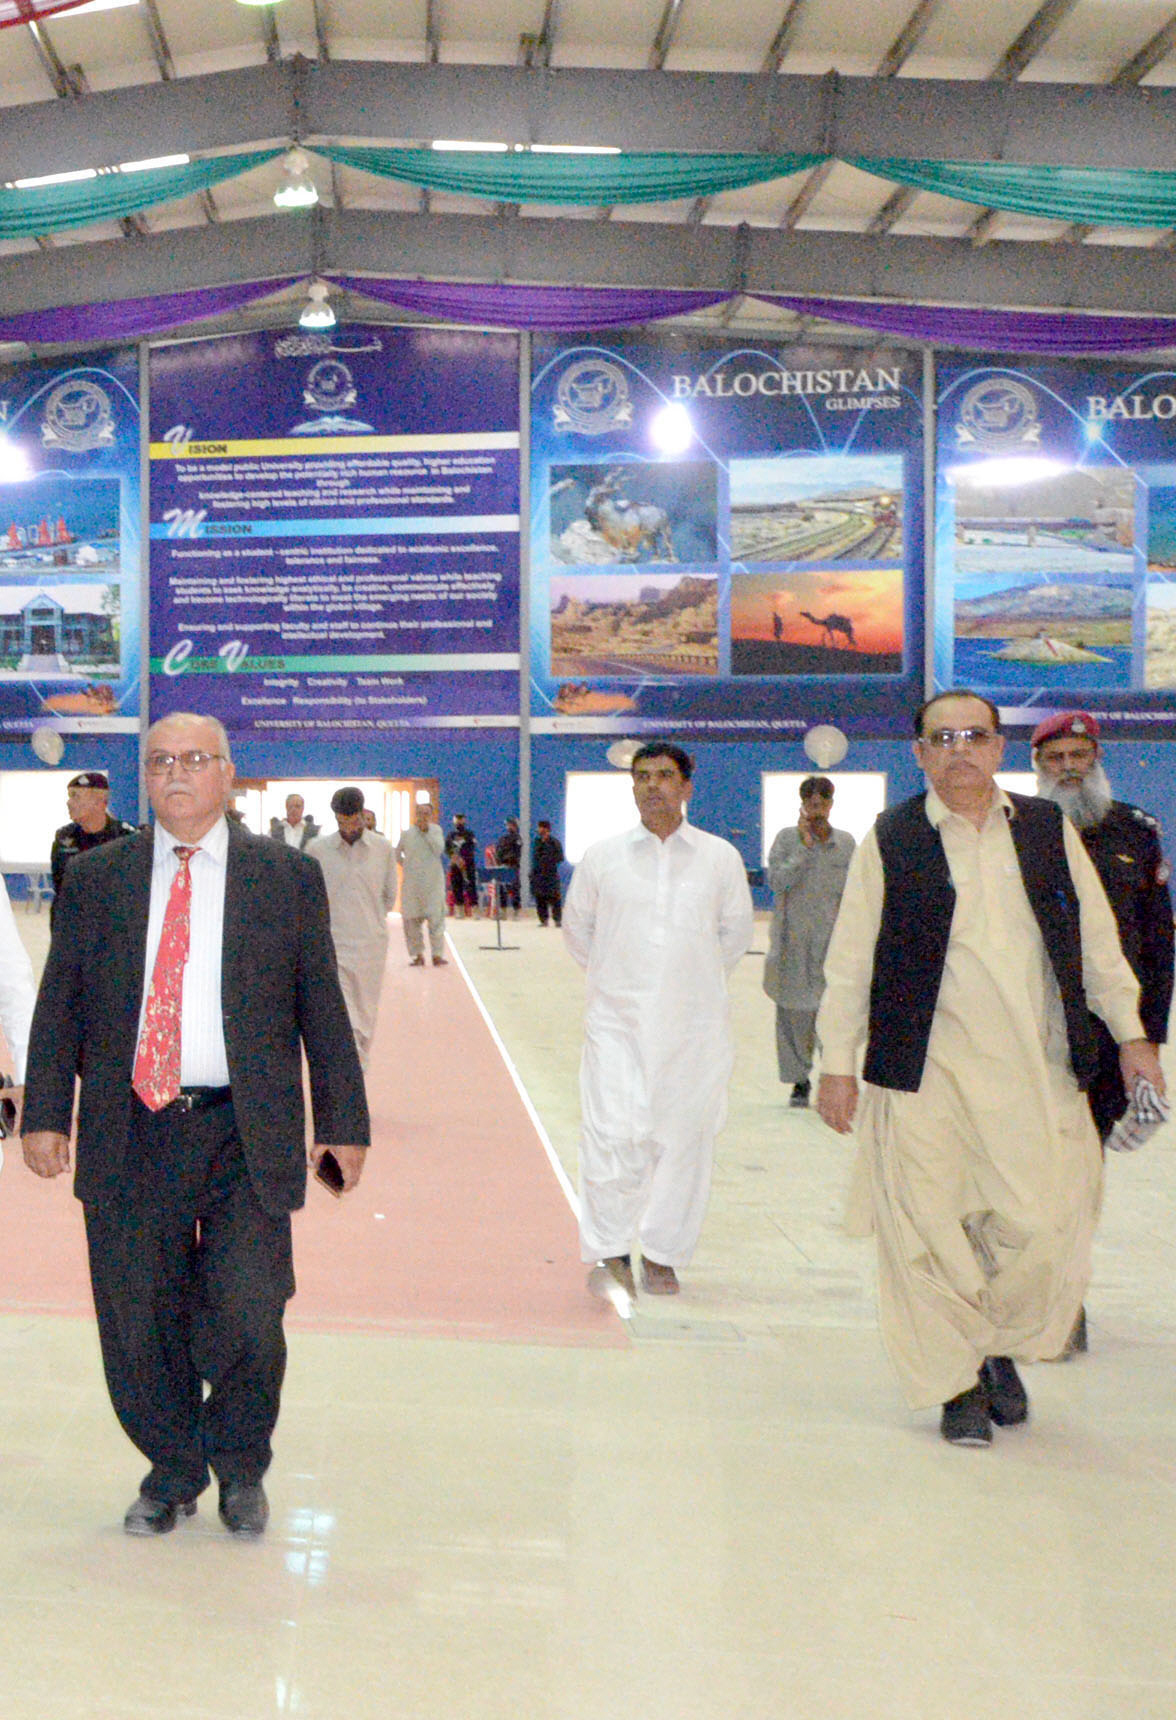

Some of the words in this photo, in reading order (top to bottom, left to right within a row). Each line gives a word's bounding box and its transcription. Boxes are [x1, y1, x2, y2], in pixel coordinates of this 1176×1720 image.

[672, 367, 902, 398] BALOCHISTAN
[825, 396, 902, 411] GLIMPSES
[162, 508, 252, 538] MISSION
